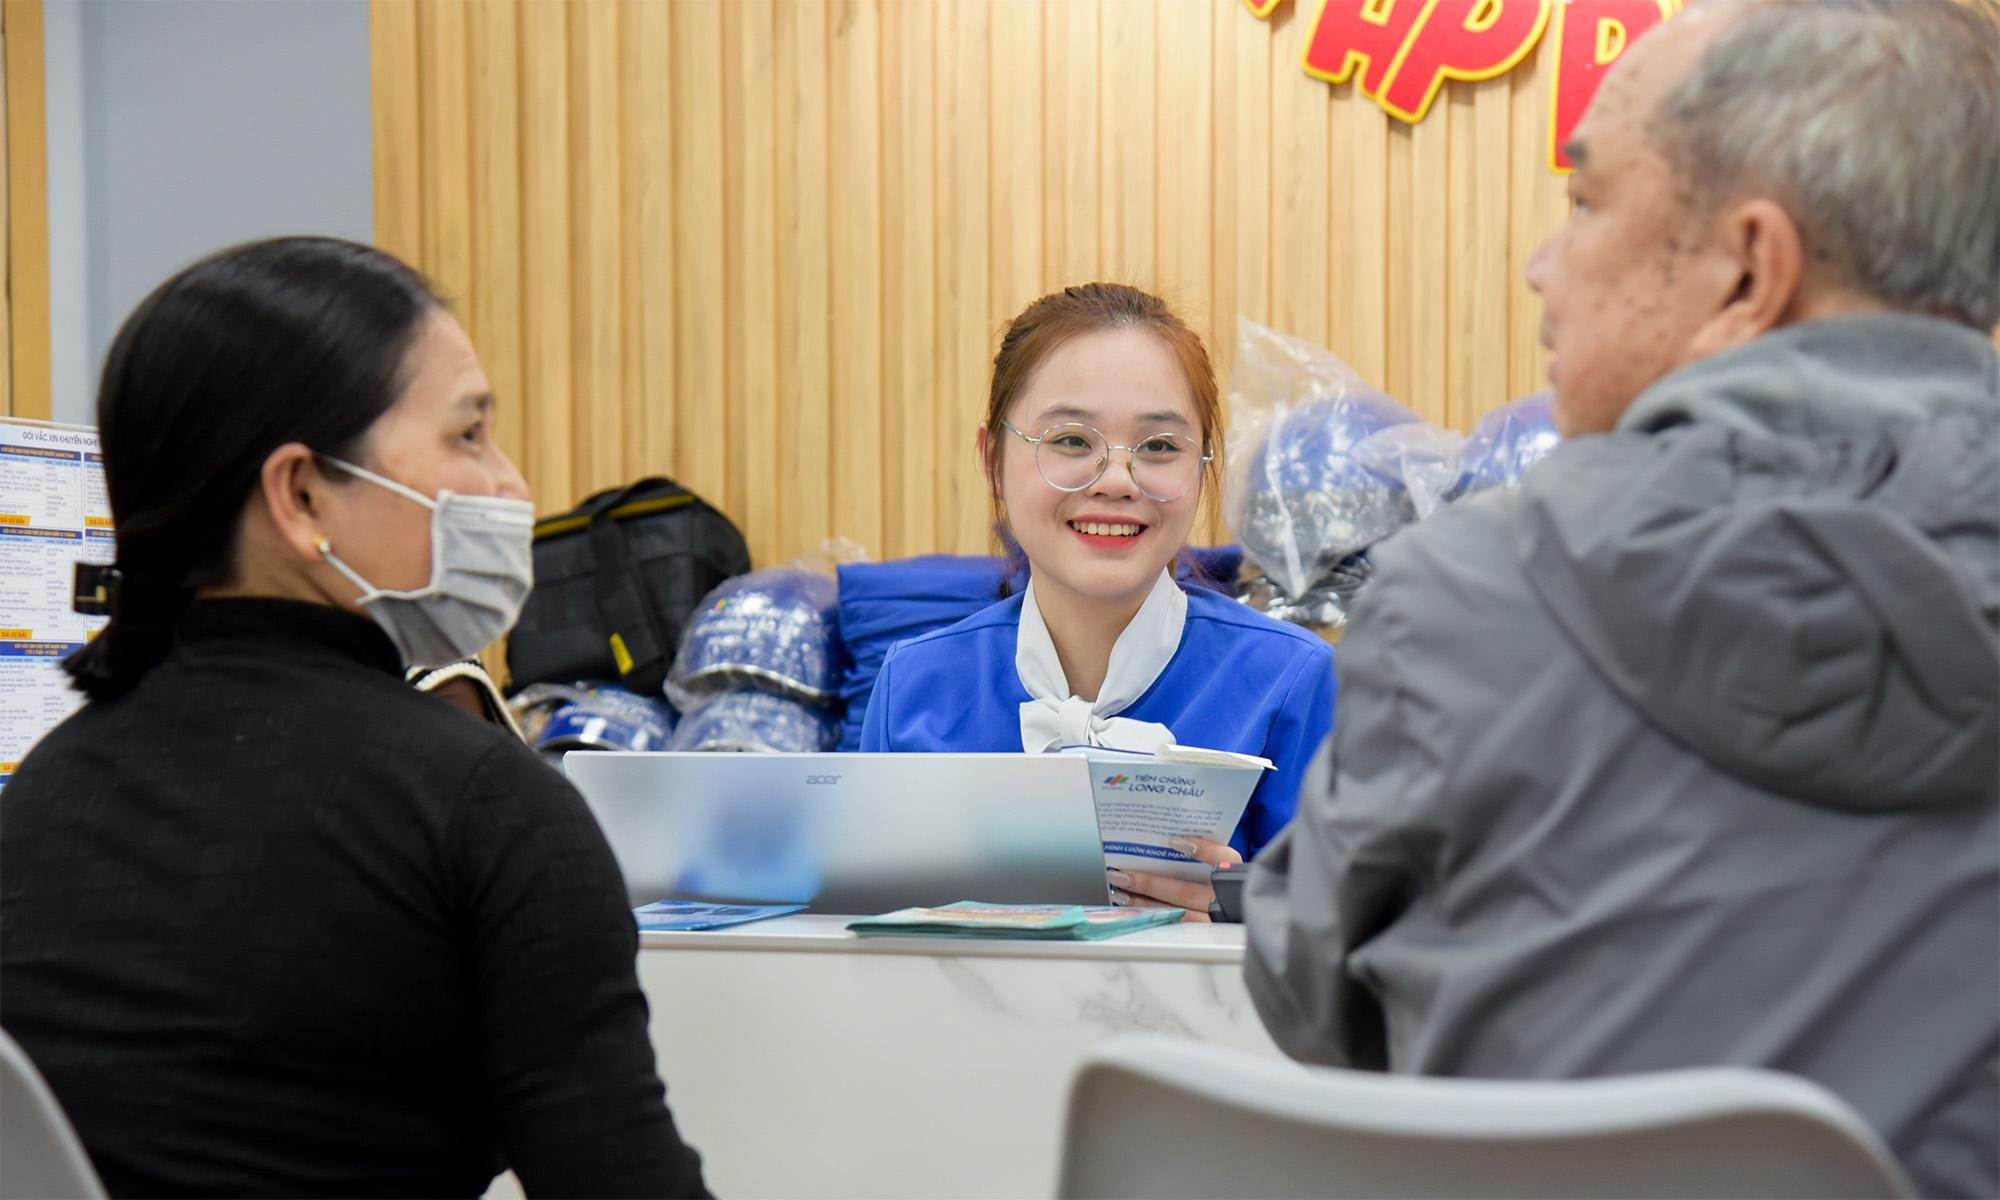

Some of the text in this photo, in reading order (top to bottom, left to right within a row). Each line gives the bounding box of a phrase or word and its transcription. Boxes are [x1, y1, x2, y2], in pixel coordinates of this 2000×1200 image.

[806, 775, 842, 785] acer
[1135, 774, 1157, 782] TIÊM
[1129, 783, 1164, 793] LONG
[1168, 785, 1205, 797] CHÂU
